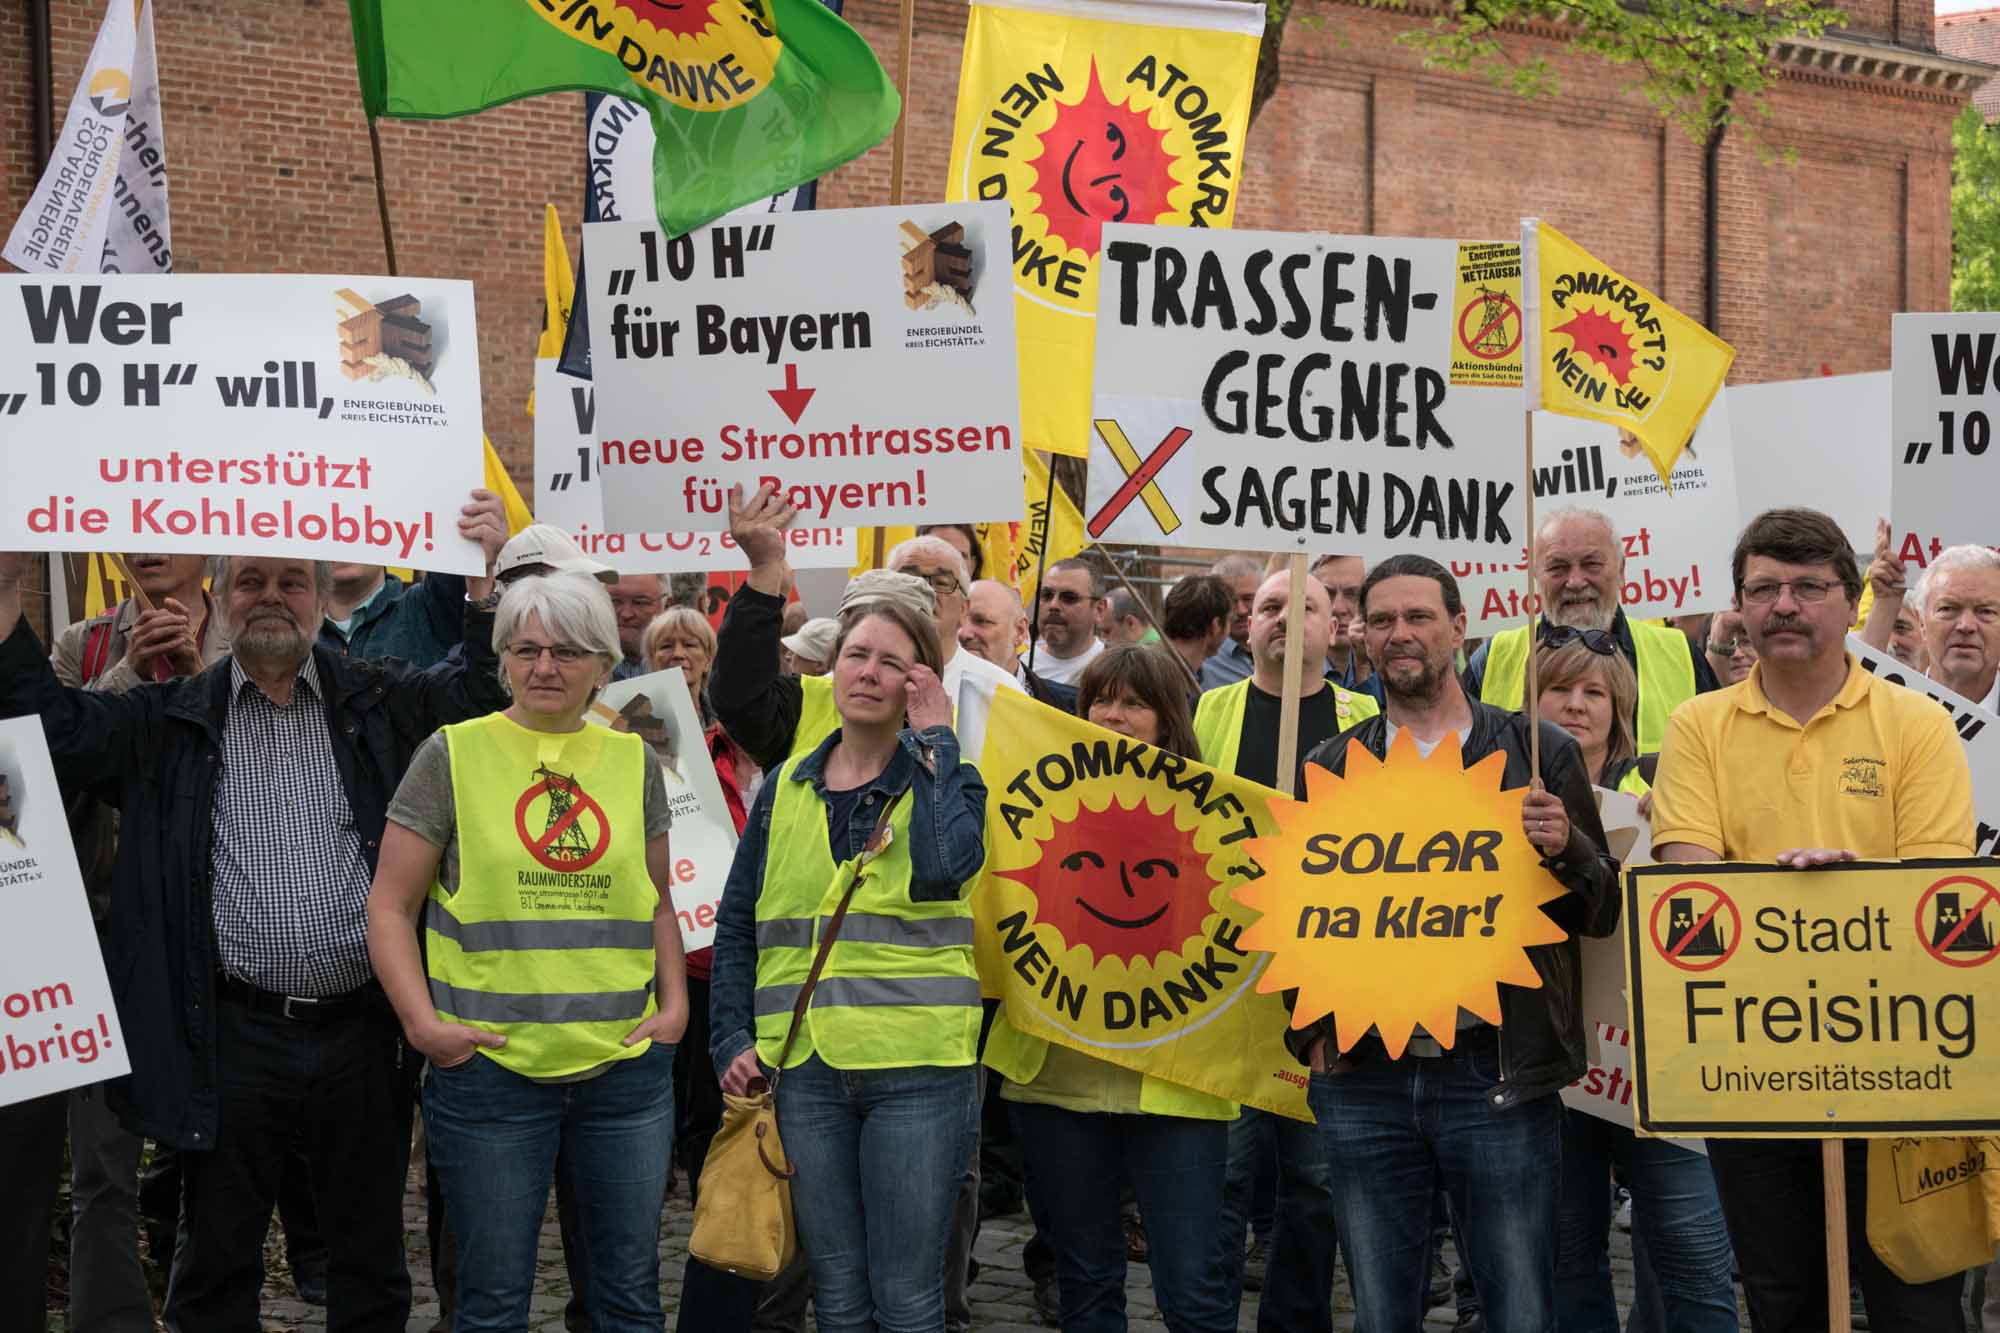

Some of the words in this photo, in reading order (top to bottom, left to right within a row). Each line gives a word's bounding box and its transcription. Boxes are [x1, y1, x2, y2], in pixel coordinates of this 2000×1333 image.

[617, 35, 756, 104] DANKE
[981, 63, 1065, 158] NEIN
[1462, 266, 1521, 283] NETZAUSBA
[1468, 246, 1521, 262] Energiewend
[20, 285, 183, 345] Wer
[1107, 241, 1438, 343] TRASSEN-
[611, 303, 680, 359] für
[697, 304, 871, 364] Bayern
[216, 361, 335, 419] will,
[1202, 349, 1455, 450] GEGNER
[1552, 347, 1607, 402] NEIN
[341, 413, 367, 421] KREIS
[368, 412, 432, 425] EICHSTÄTT
[343, 399, 446, 414] ENERGIEBÜNDEL
[100, 451, 371, 489] unterstützt
[603, 433, 704, 465] neue
[719, 423, 1012, 462] Stromtrassen
[1533, 445, 1618, 498] will,
[27, 496, 109, 534] die
[132, 498, 434, 558] Kohlelobby!
[1200, 465, 1370, 534] SAGEN
[1384, 471, 1514, 544] DANK
[999, 739, 1267, 881] ATOMKRAFT?
[518, 871, 611, 889] RAUMWIDERSTAND
[1301, 830, 1503, 875] SOLAR
[1297, 904, 1361, 939] na
[1374, 894, 1504, 939] klar!
[1754, 905, 1892, 953] Stadt
[996, 910, 1088, 1021] NEIN
[1104, 918, 1249, 1030] DANKE
[1685, 978, 1976, 1058] Freising
[1701, 1065, 1953, 1092] Universitätsstadt
